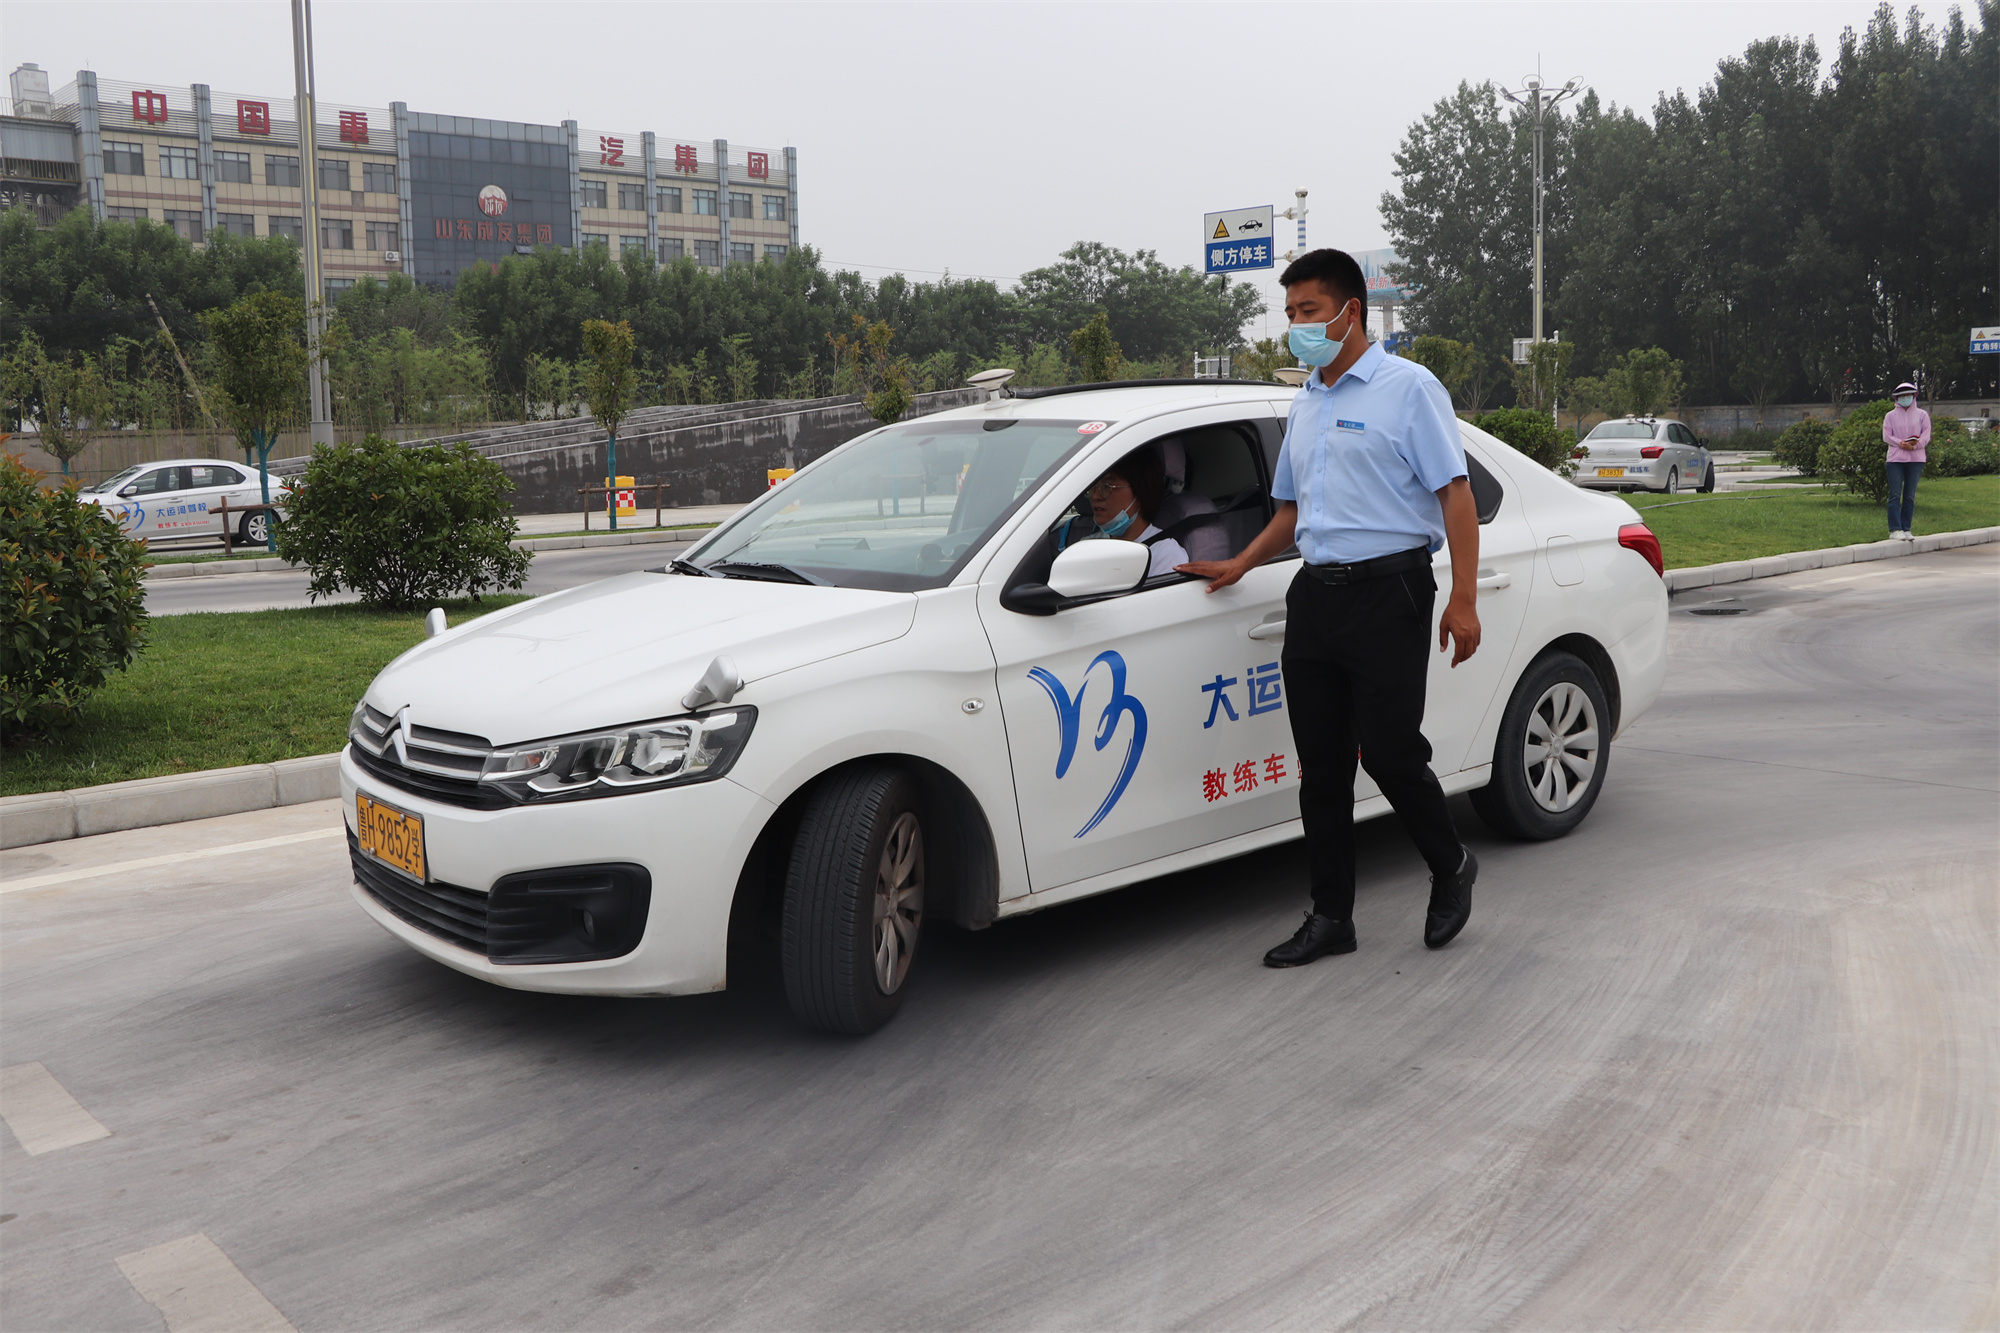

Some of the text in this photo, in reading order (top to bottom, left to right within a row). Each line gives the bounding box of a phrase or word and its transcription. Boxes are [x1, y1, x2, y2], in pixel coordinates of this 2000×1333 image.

[435, 218, 552, 244] 山东成友集团
[1210, 244, 1268, 268] 侧方停车
[1973, 341, 2000, 352] 直角转
[1085, 423, 1103, 431] 18
[155, 502, 207, 518] 大运河驾校
[158, 521, 178, 529] 教练车
[1201, 661, 1283, 729] 大运
[1202, 753, 1287, 802] 教练车
